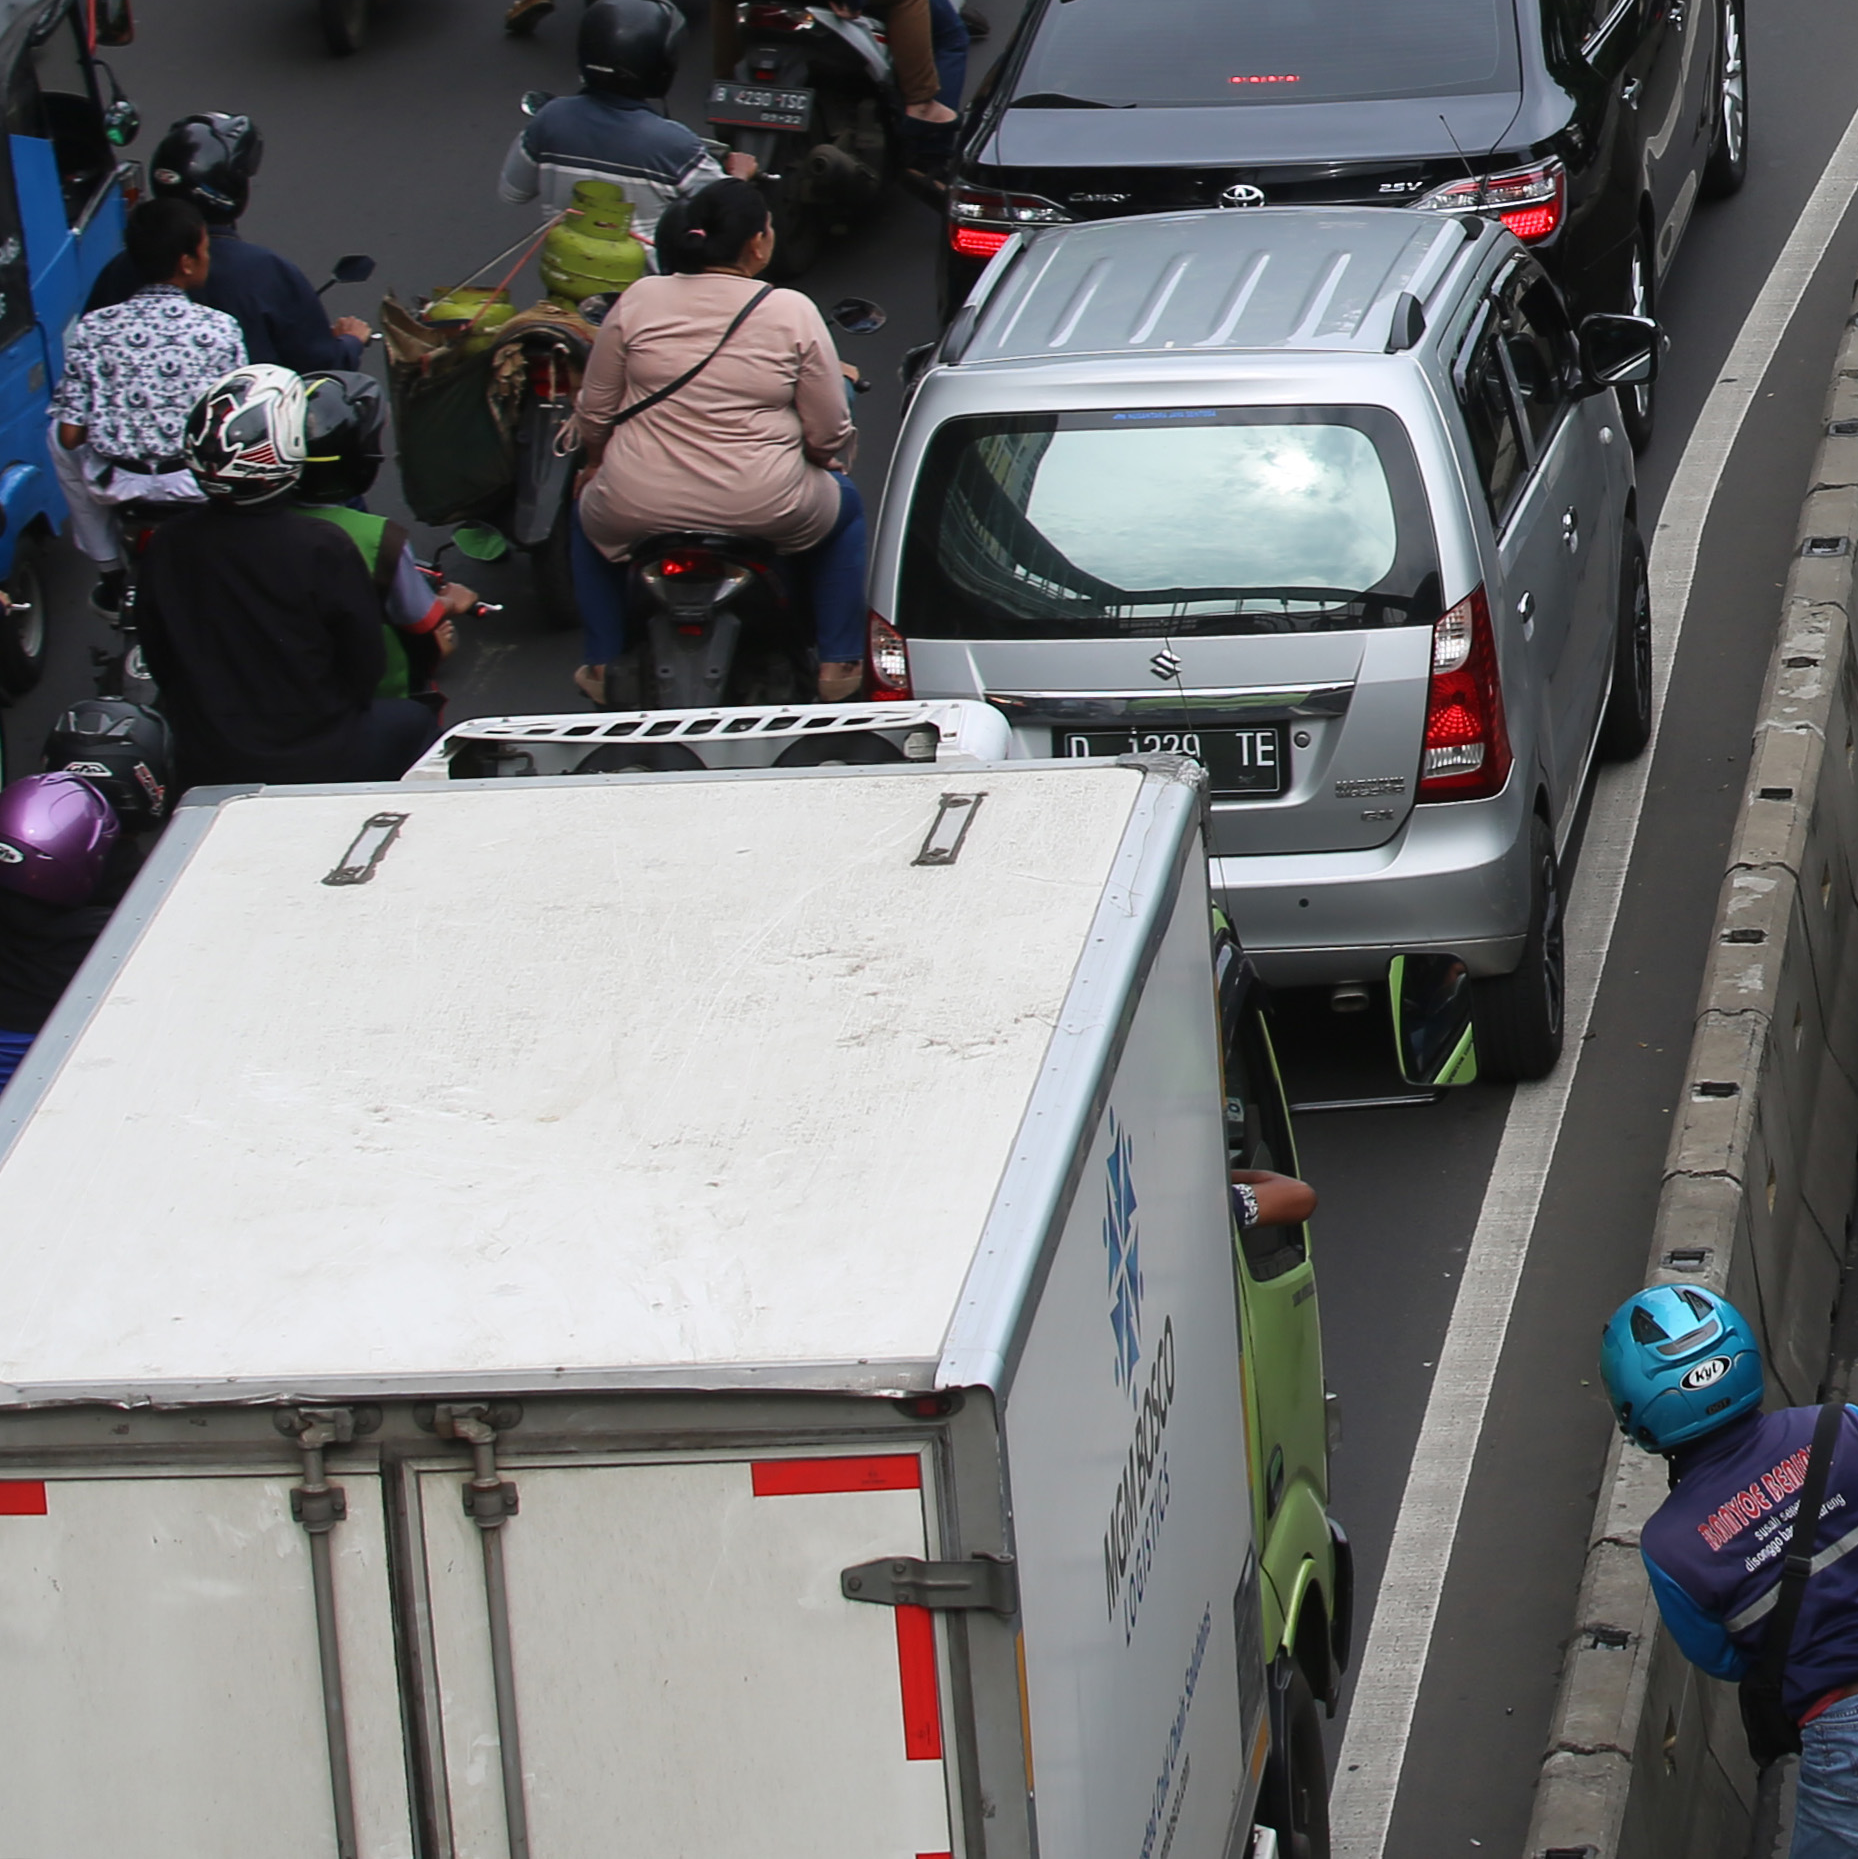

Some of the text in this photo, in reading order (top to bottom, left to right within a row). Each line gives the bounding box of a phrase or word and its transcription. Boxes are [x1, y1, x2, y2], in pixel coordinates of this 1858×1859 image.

[712, 86, 727, 102] B
[1235, 733, 1275, 767] TE
[1744, 1537, 1785, 1573] disonggo
